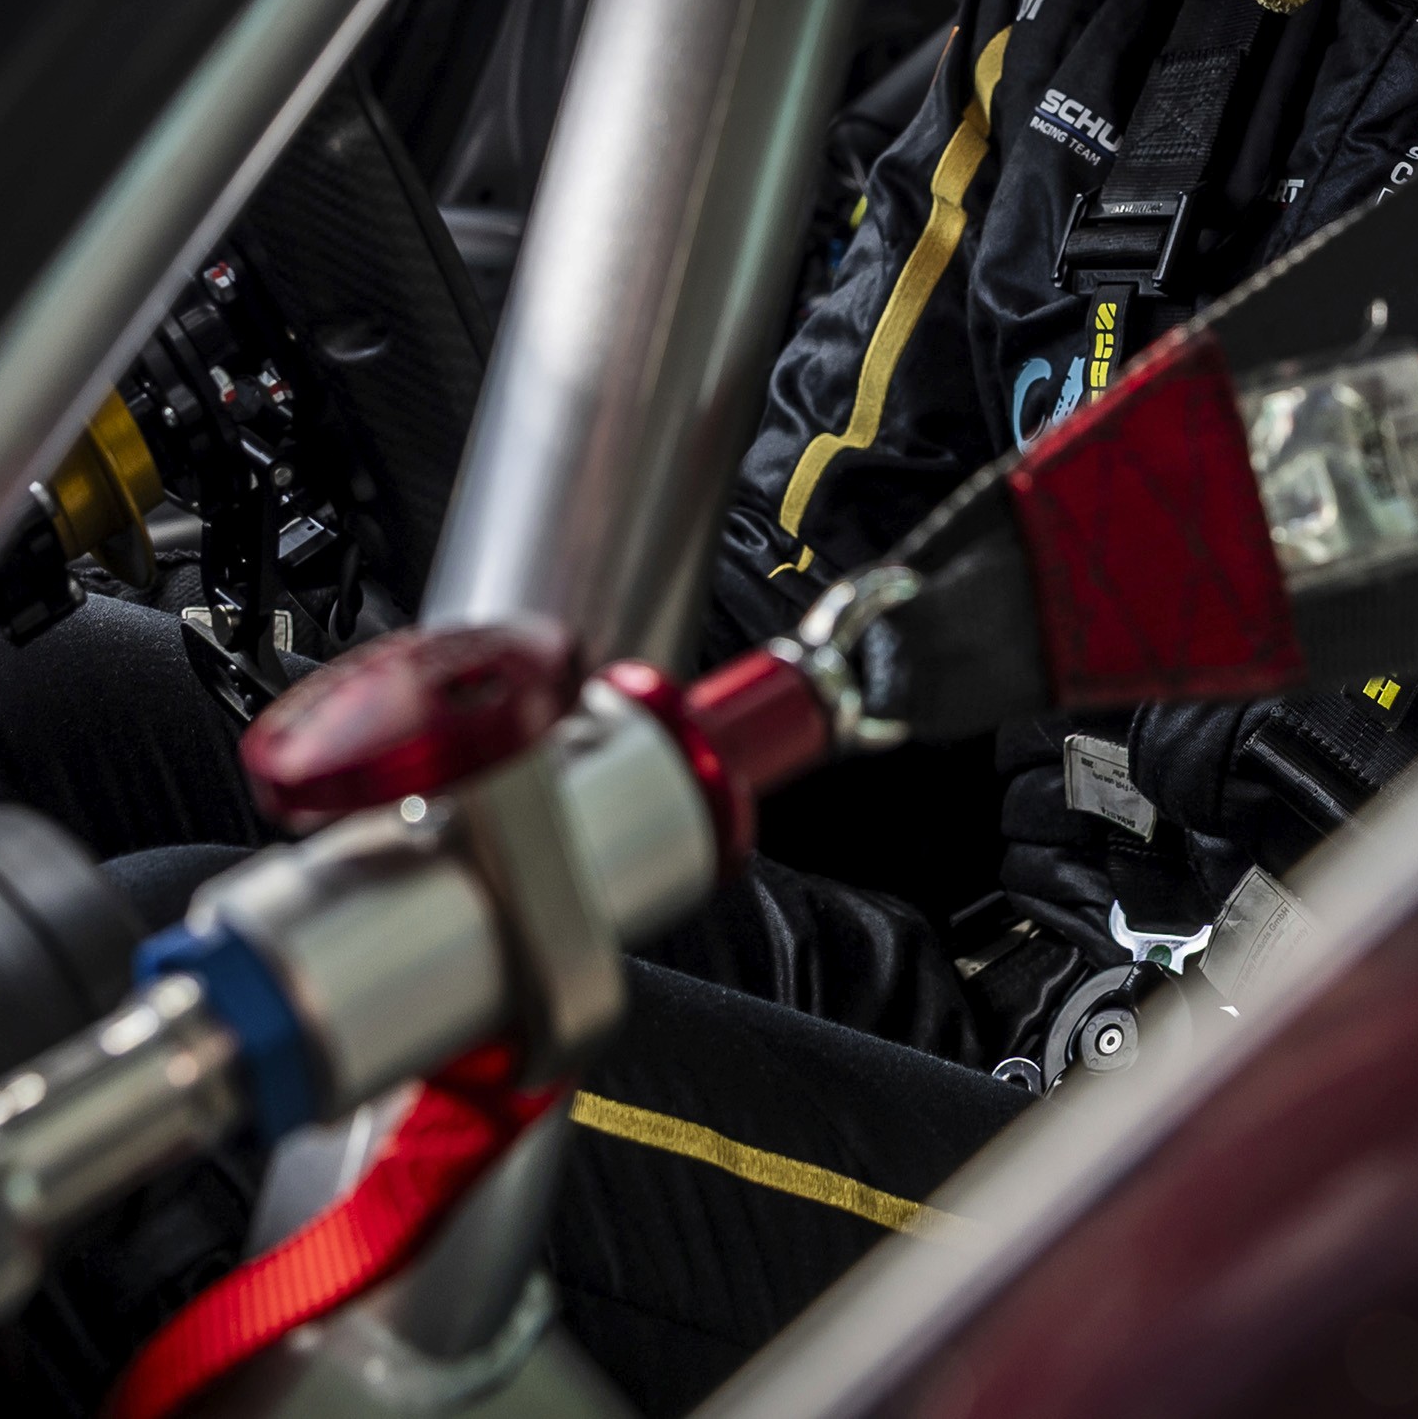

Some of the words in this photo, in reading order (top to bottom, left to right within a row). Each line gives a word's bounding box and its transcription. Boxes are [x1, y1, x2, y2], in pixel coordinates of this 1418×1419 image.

[1030, 116, 1067, 143] RACING
[1068, 137, 1102, 166] TEAM
[1039, 87, 1124, 153] SCHU
[1268, 906, 1291, 932] GmbH
